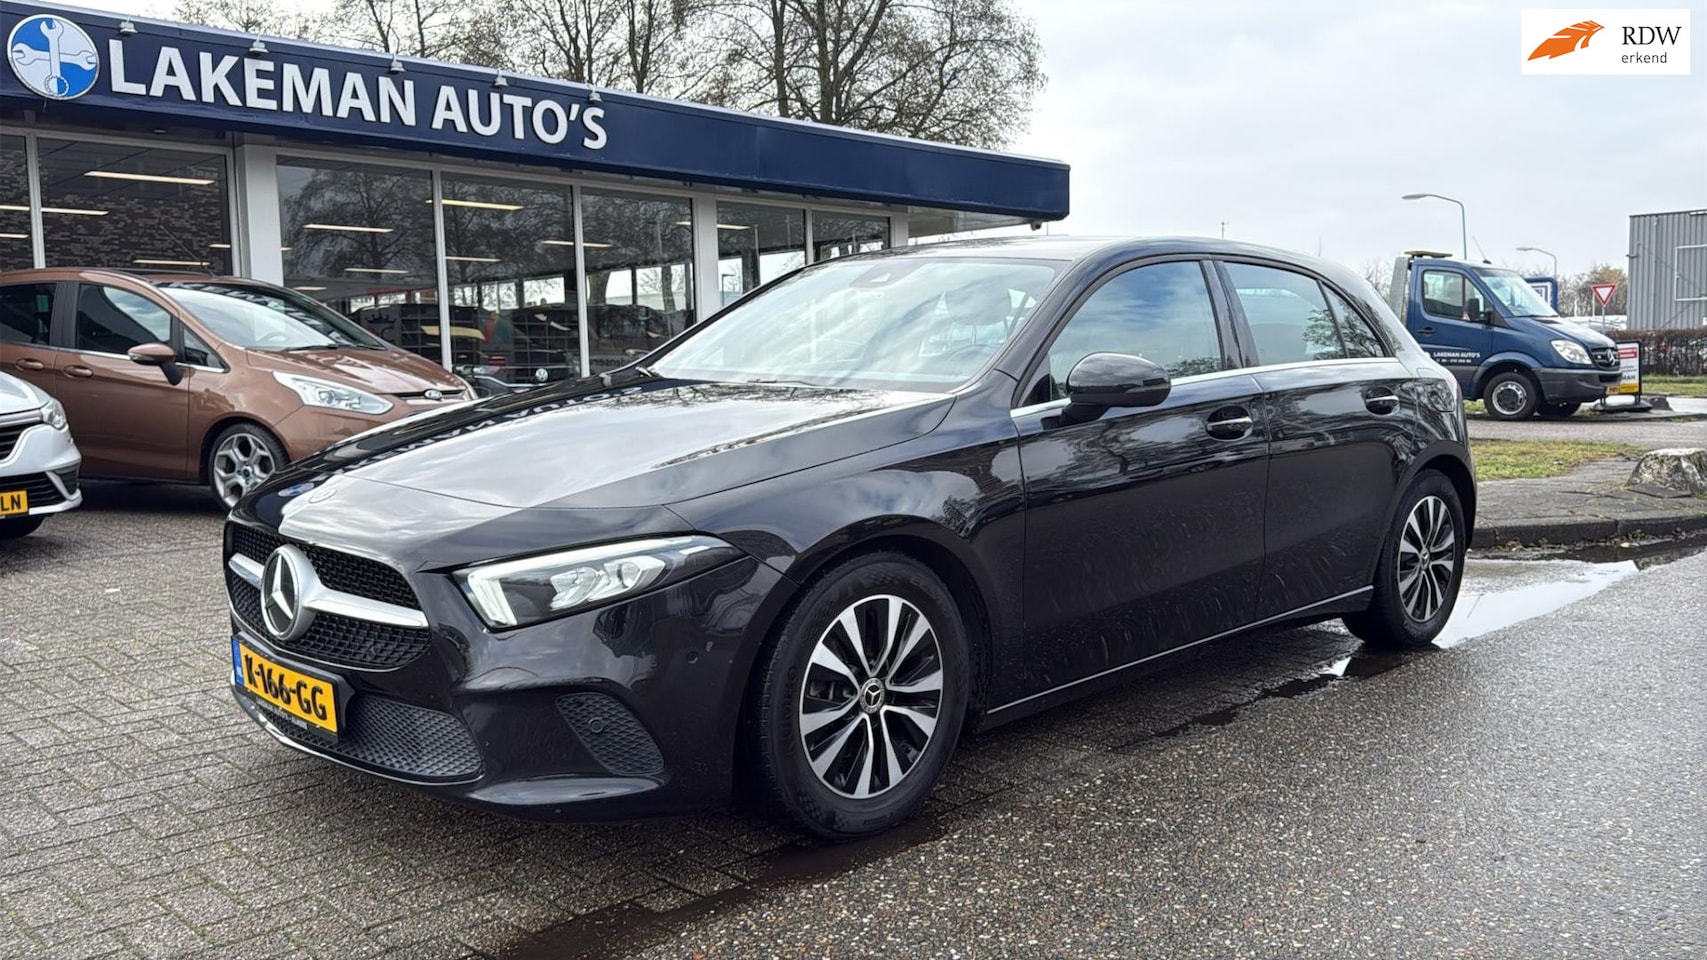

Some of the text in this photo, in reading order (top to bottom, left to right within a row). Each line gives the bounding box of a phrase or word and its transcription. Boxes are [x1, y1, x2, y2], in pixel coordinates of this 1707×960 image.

[108, 39, 608, 150] LAKEMAN AUTO'S
[244, 654, 328, 721] K-166-GG
